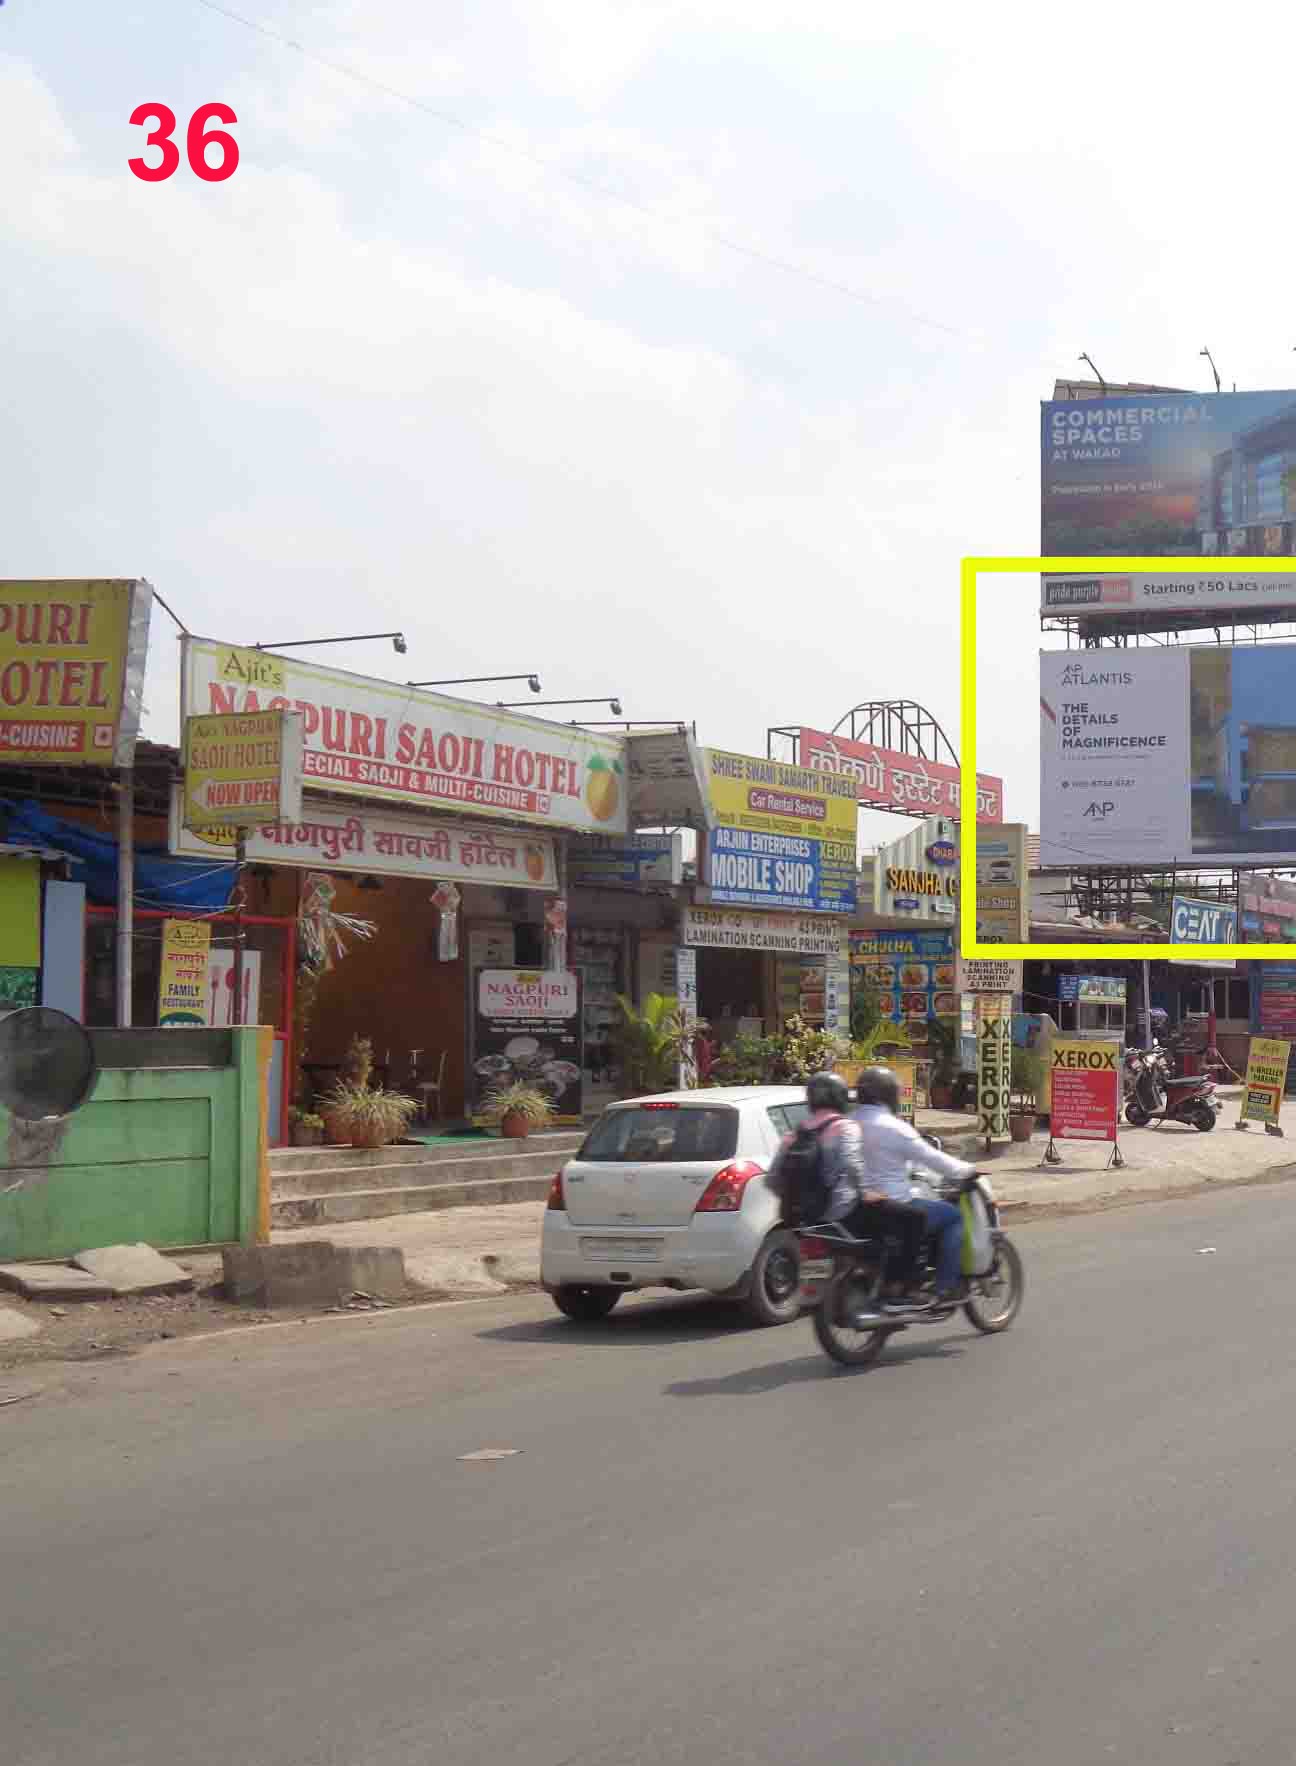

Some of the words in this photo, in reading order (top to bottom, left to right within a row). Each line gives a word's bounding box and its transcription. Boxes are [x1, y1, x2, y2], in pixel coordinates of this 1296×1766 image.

[1053, 404, 1213, 427] COMMERCIAL
[1053, 426, 1143, 446] SPACES
[1053, 449, 1068, 461] AT
[1143, 583, 1195, 595] Starting
[1228, 580, 1258, 592] Lacs
[223, 652, 283, 687] Ajit's
[1062, 672, 1133, 686] ATLANTIS
[1, 660, 112, 708] OTEL
[1062, 703, 1089, 714] THE
[1062, 714, 1119, 726] DETAILS
[208, 683, 388, 758] NPURI
[395, 722, 486, 778] SAOJI
[495, 743, 581, 799] HOTEL
[1062, 726, 1081, 738] OF
[1062, 735, 1168, 750] MAGNIFICENCE
[304, 752, 353, 780] ECIAL
[357, 761, 404, 786] SAOJI
[408, 771, 420, 788] &
[423, 774, 529, 809] MULTI-CUISINE
[712, 757, 744, 780] SHREE
[751, 791, 767, 808] Car
[768, 794, 794, 812] Rental
[795, 799, 825, 817] Service
[751, 832, 811, 858] ENTERPRISES
[711, 853, 771, 891] MOBILE
[775, 860, 814, 895] SHOP
[888, 864, 944, 896] SANJHA
[1175, 905, 1219, 941] CEAT
[687, 928, 747, 945] LAMINATION
[750, 934, 797, 949] SCANNING
[799, 938, 840, 953] PRINTING
[488, 984, 569, 997] NAGPURI
[1053, 1049, 1116, 1070] XEROX
[980, 1018, 1000, 1134] XEROX
[1001, 1018, 1011, 1133] XEROX
